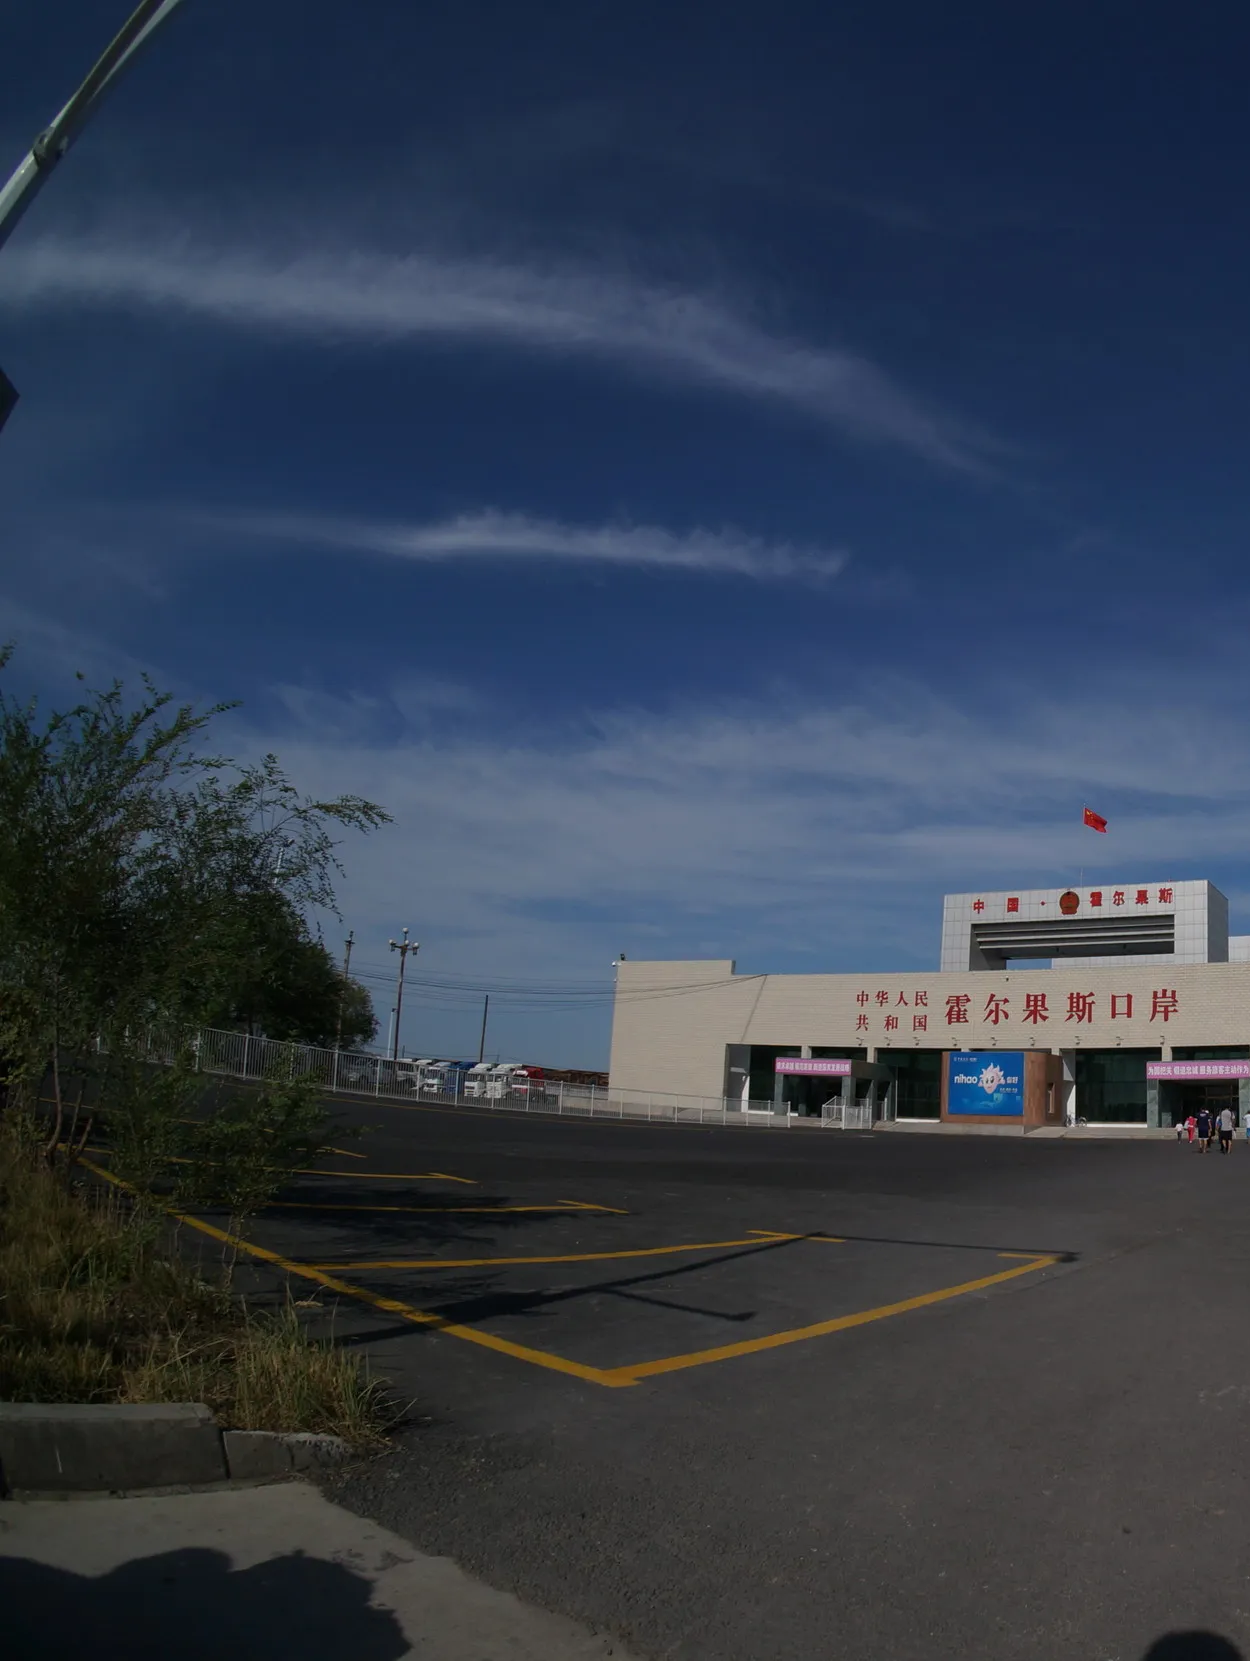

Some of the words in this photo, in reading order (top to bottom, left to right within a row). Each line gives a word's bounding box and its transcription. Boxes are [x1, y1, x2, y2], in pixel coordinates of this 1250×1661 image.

[1090, 887, 1174, 907] 霍尔果斯
[856, 990, 928, 1007] 中华人民
[945, 988, 1179, 1025] 霍尔果斯口岸
[855, 1014, 928, 1032] 共和国
[954, 1074, 978, 1084] nihao
